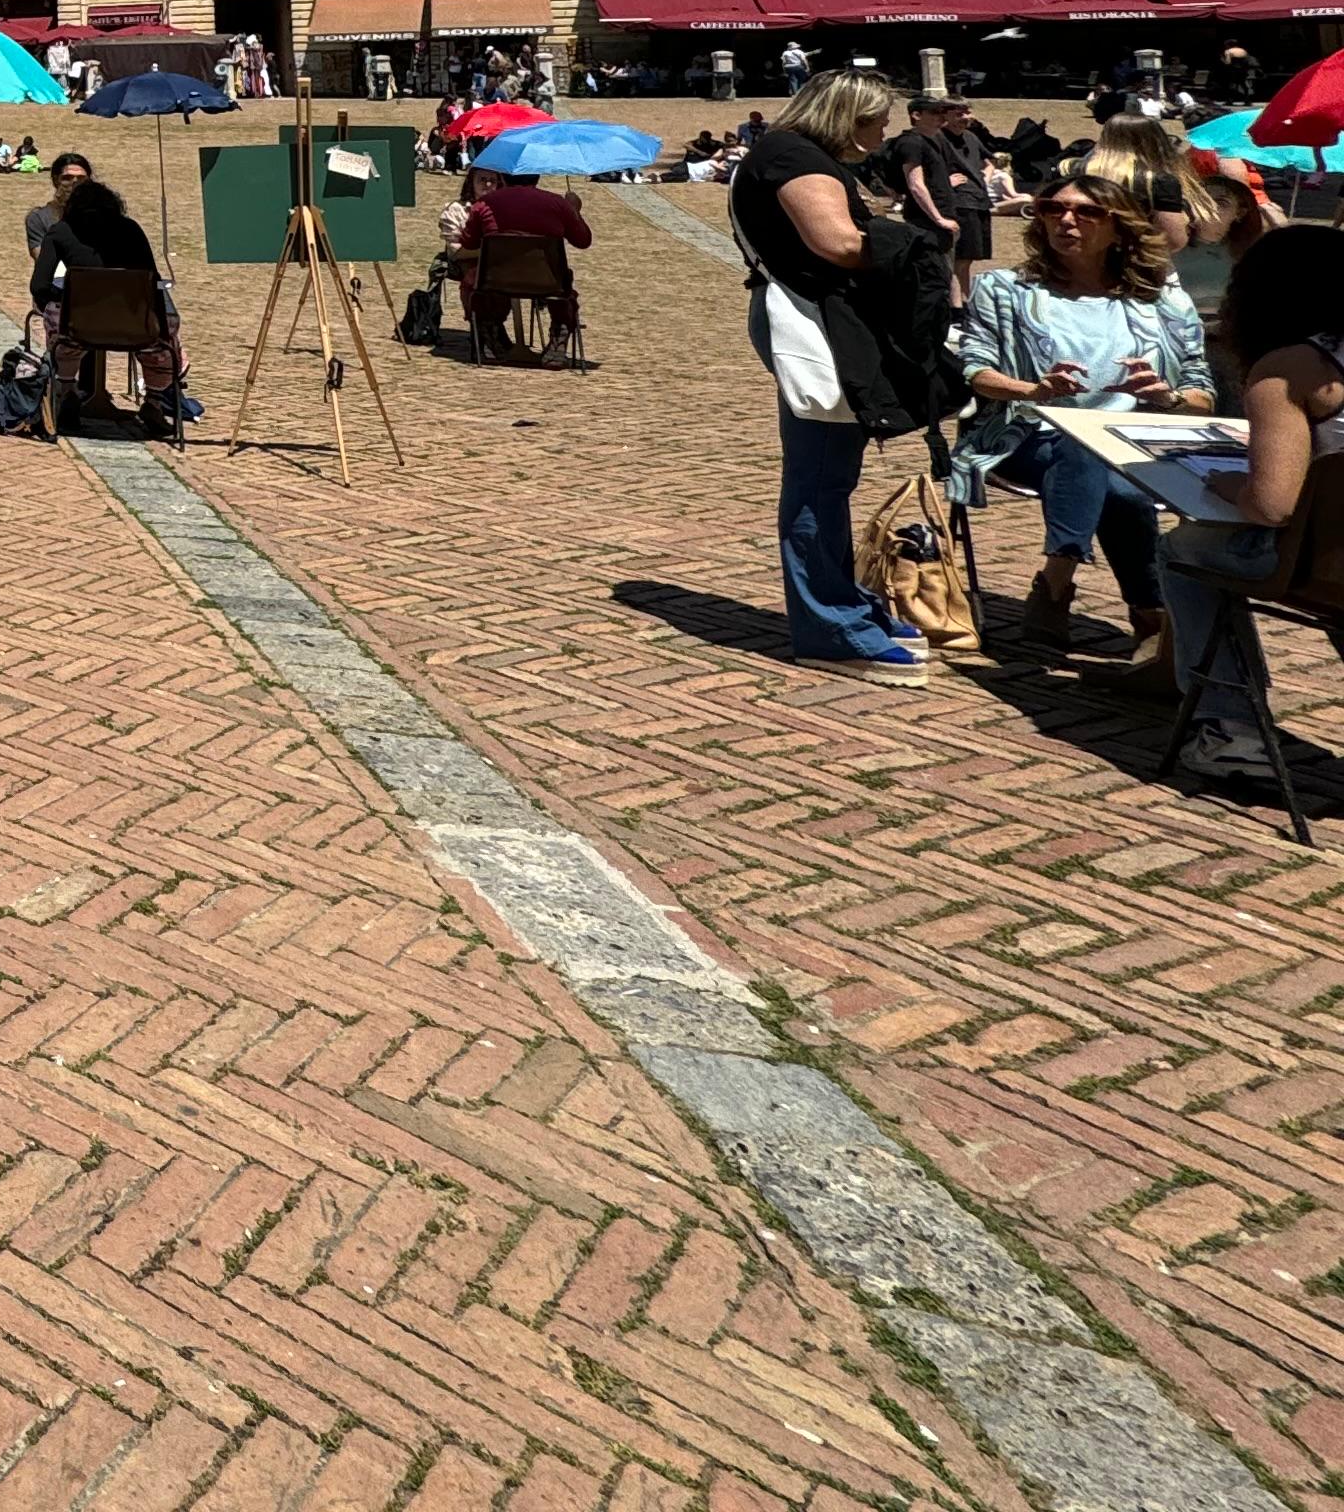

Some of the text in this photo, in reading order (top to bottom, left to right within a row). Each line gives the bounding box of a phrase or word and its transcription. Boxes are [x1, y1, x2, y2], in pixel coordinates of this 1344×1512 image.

[1069, 11, 1157, 20] RISTORANTE
[690, 21, 766, 29] CAFFETTERIA
[438, 27, 548, 37] SOUVENIRS
[314, 32, 415, 42] SOUVENIRS
